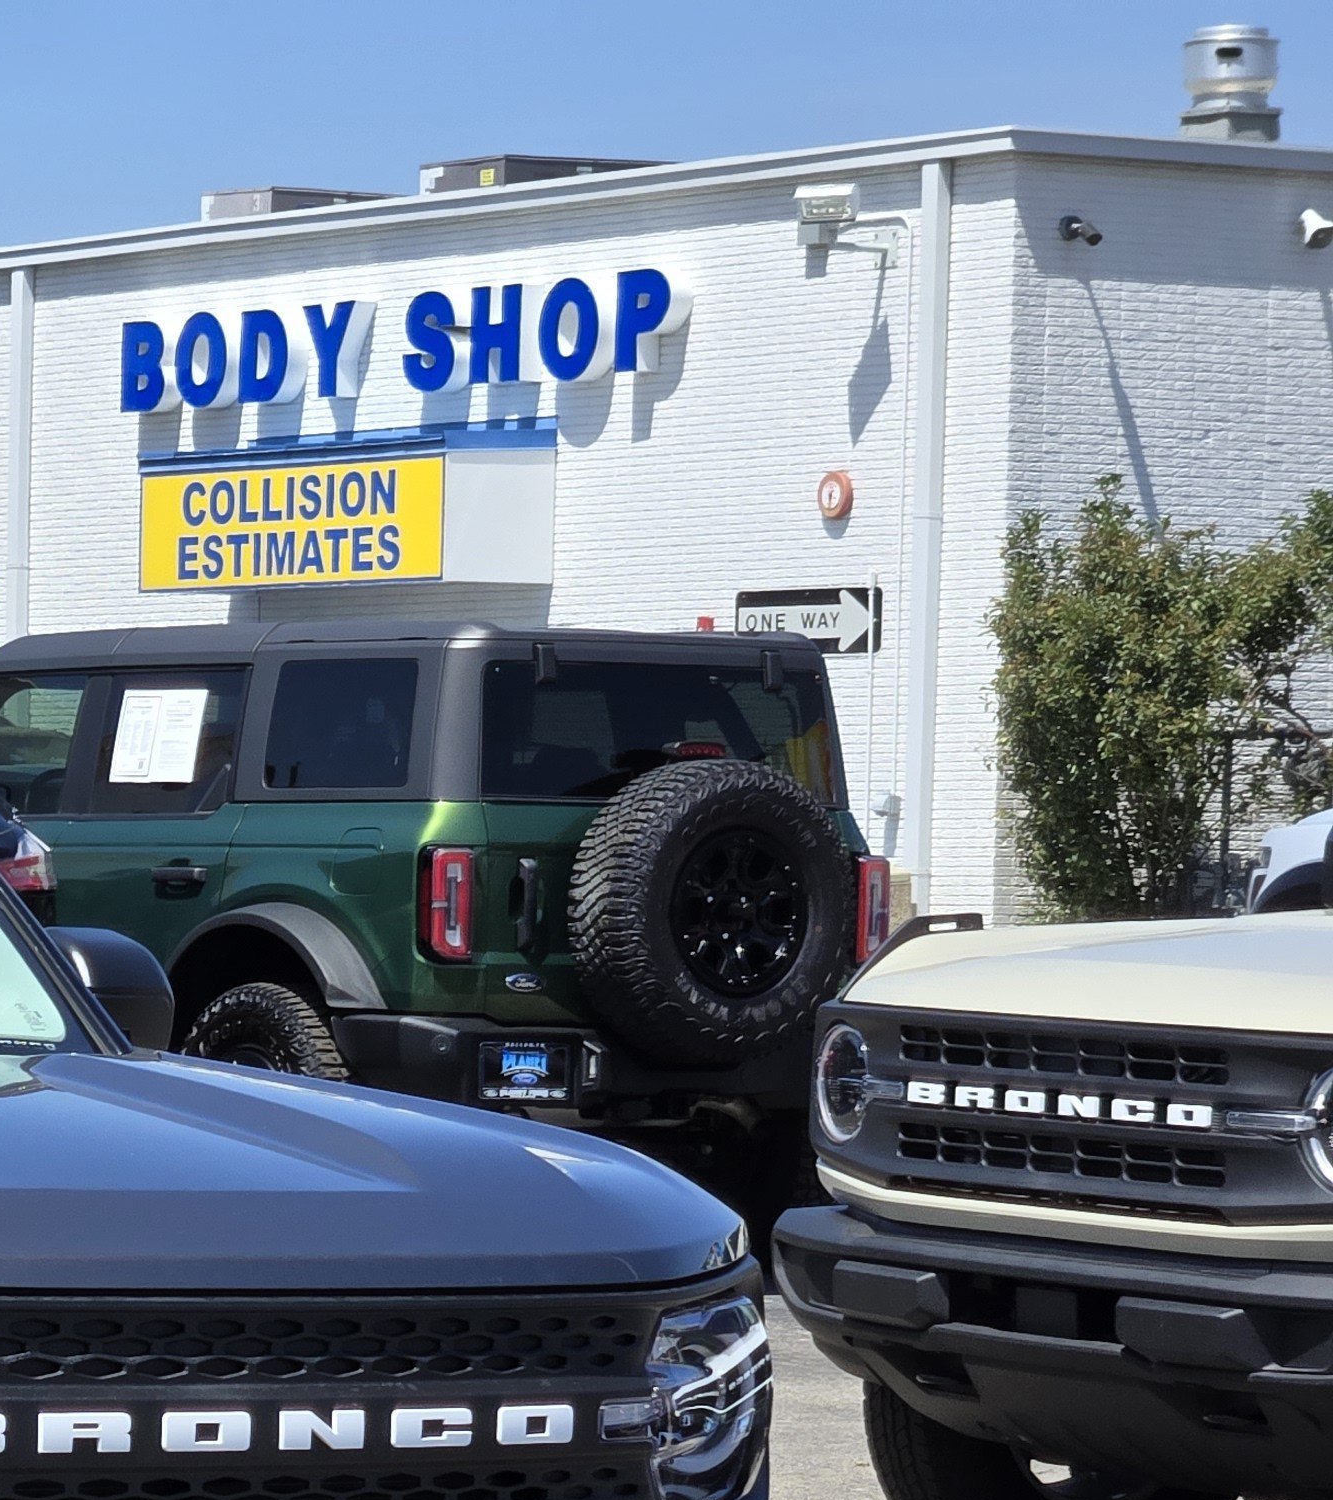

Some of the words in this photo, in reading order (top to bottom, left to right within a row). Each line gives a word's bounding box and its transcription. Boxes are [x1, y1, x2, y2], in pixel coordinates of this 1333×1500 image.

[121, 300, 356, 413] BODY
[403, 267, 671, 394] SHOP
[182, 469, 397, 527] COLLISION
[177, 525, 401, 581] ESTIMATES
[745, 613, 786, 633] ONE
[800, 611, 841, 630] WAY
[906, 1080, 1213, 1128] BRONCO
